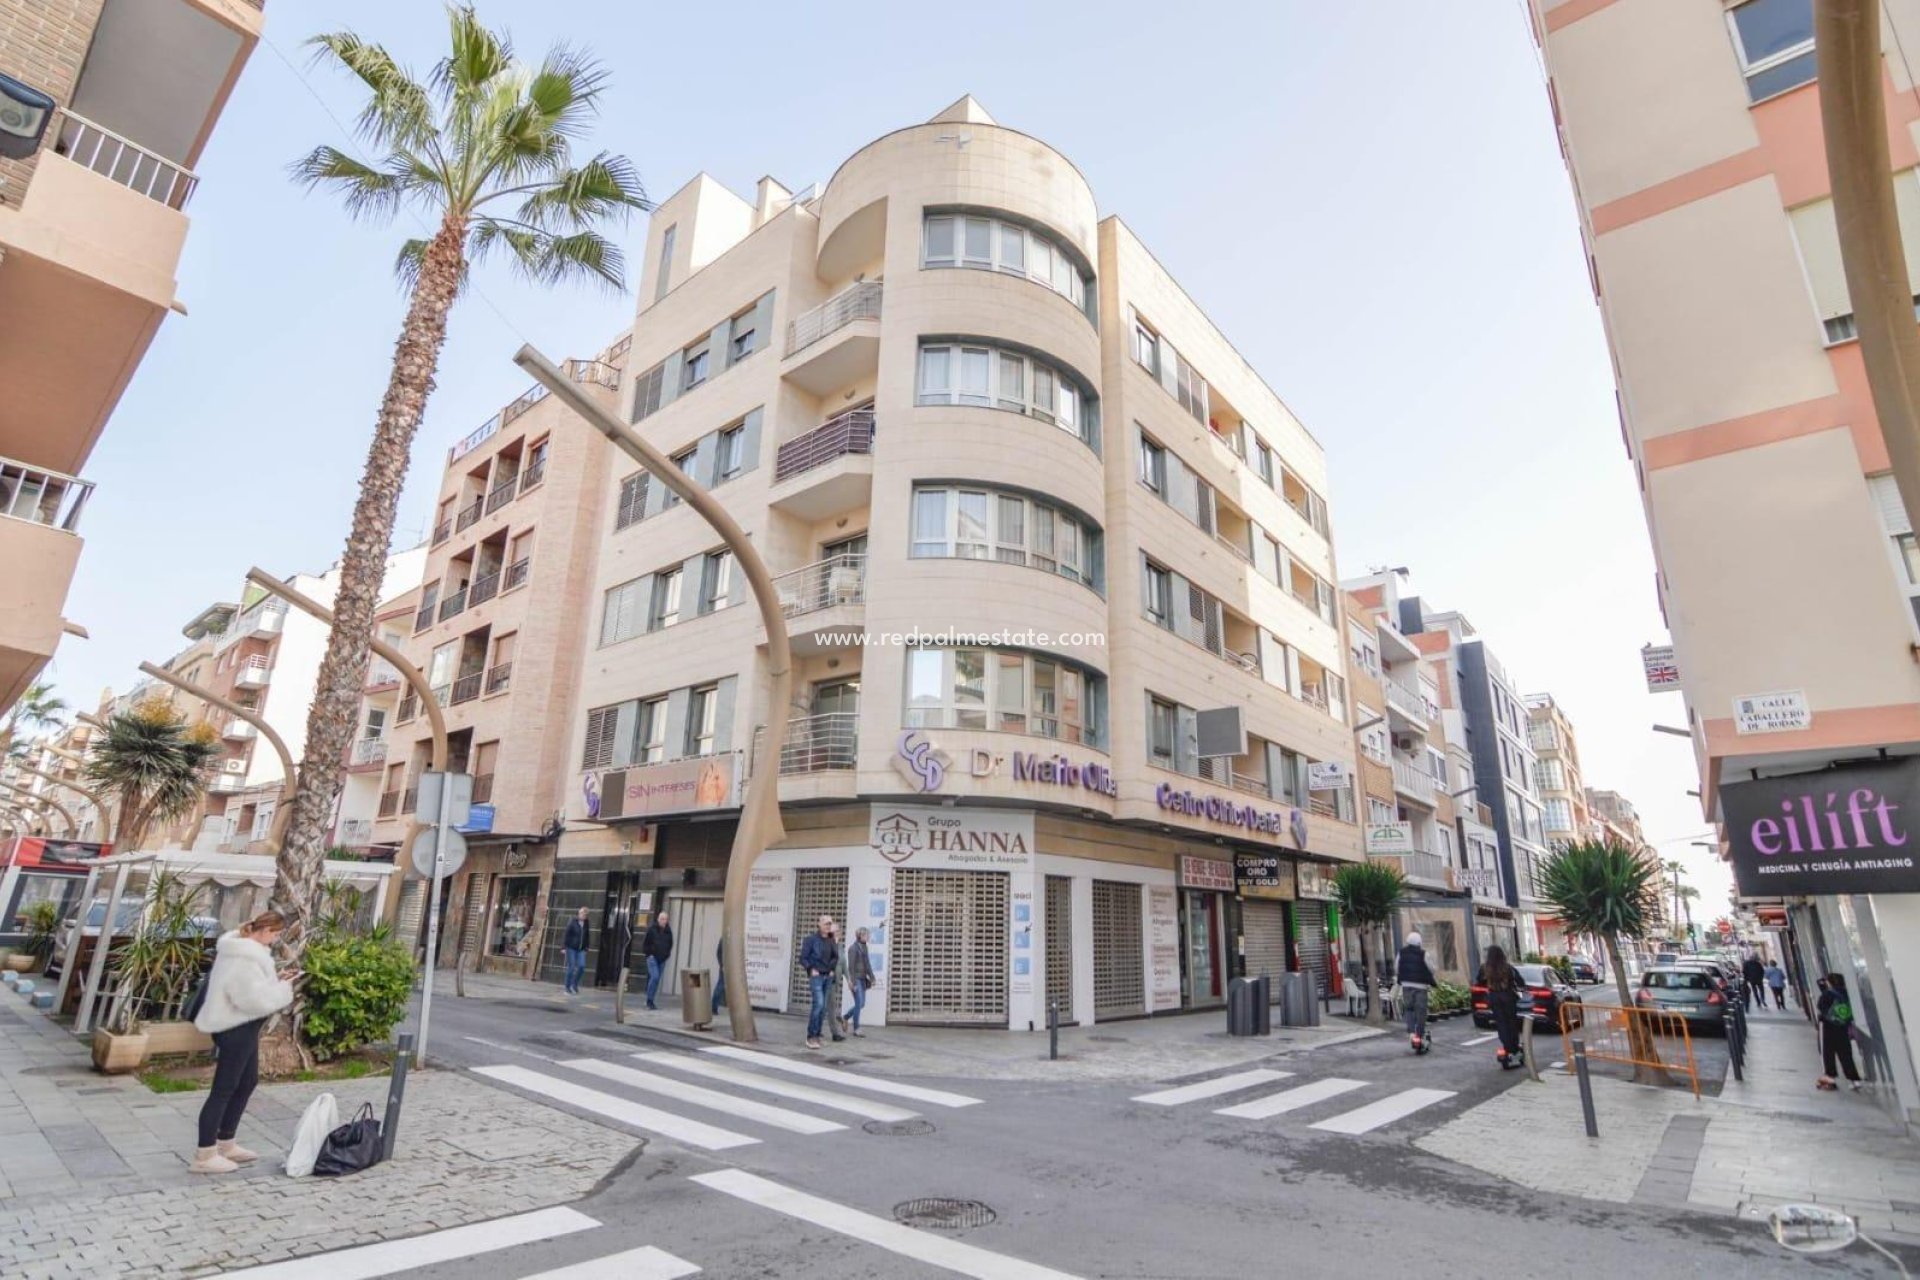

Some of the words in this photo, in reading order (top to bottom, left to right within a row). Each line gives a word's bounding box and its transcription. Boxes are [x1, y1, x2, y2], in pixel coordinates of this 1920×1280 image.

[971, 749, 1004, 777] Dr
[628, 785, 650, 798] SIN
[651, 781, 696, 794] INTERESES
[928, 817, 961, 828] Grupo
[1751, 789, 1907, 855] eilíft
[928, 829, 1028, 854] HANNA
[948, 854, 987, 863] Abogados
[1237, 858, 1277, 867] COMPRO
[1758, 863, 1800, 874] MEDICINA
[1803, 863, 1809, 871] Y
[1854, 857, 1914, 870] ANTIAGING
[1247, 867, 1267, 876] ORO
[1255, 878, 1279, 886] GOLD
